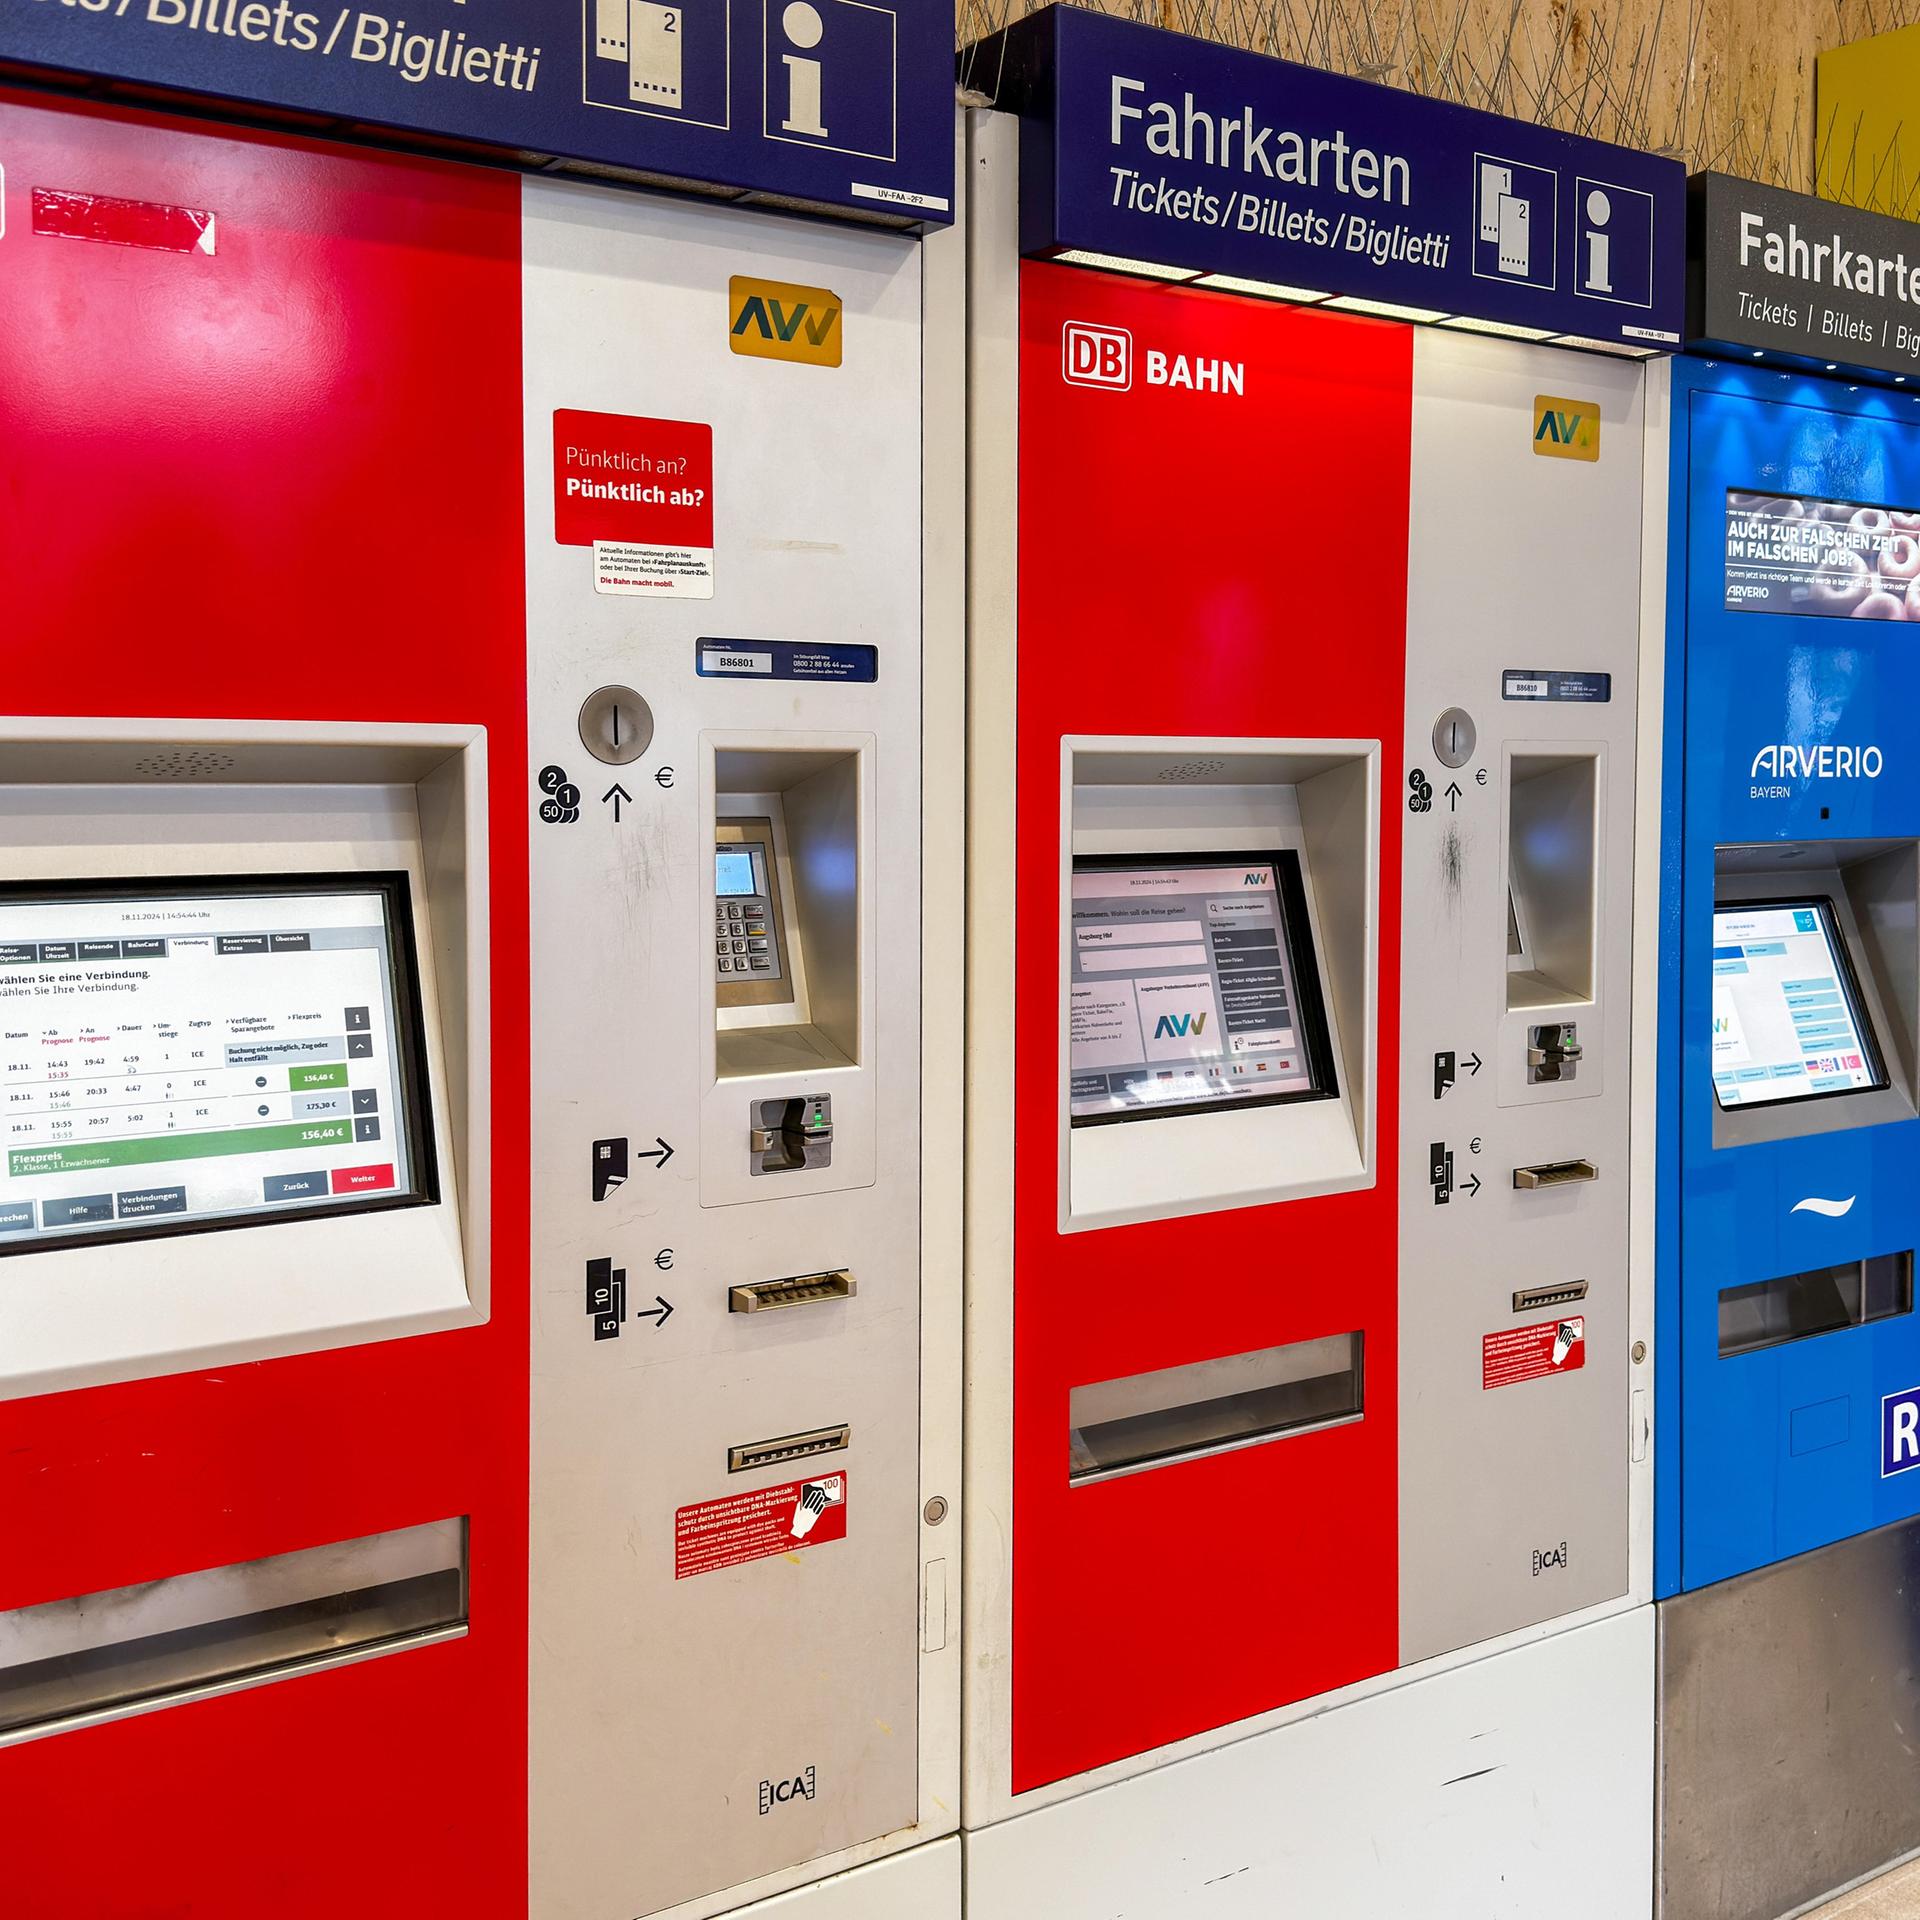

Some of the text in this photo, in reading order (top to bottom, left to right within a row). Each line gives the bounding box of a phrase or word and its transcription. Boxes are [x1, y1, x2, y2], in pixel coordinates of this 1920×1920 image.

[1110, 74, 1411, 206] Fahrkarten
[1738, 291, 1798, 327] Tickets
[1821, 309, 1873, 343] Billets
[1072, 332, 1245, 396] DB BAHN
[566, 446, 688, 476] Pünktlich an?
[566, 478, 705, 507] Pünktlich ab?
[1728, 520, 1900, 553] AUCH ZUR FALSCHEN ZEIT
[600, 547, 623, 555] Aktuelle
[624, 548, 664, 557] Informationen
[1728, 540, 1853, 568] IM FALSCHEN JOB?
[610, 556, 641, 564] Automaten
[624, 565, 639, 573] Ihrer
[640, 567, 664, 575] Buchung
[665, 567, 677, 575] über
[1727, 569, 1745, 578] Komm
[1745, 571, 1758, 580] jetzt
[1768, 573, 1789, 582] richtige
[1789, 574, 1803, 582] Team
[1804, 576, 1815, 584] und
[632, 579, 652, 587] macht
[1727, 585, 1769, 598] ARVERIO
[720, 657, 754, 668] B86801
[1750, 744, 1883, 778] ARVERIO
[547, 773, 557, 788] 2
[564, 789, 571, 804] 1
[1750, 786, 1790, 799] BAYERN
[543, 806, 559, 818] 50
[121, 912, 161, 921] 18.11.2024
[45, 945, 66, 953] Datum
[127, 941, 159, 949] BahnCard
[173, 939, 209, 947] Verbindung
[39, 970, 151, 983] Sie eine Verbindung.
[35, 982, 139, 995] Sie Ihre Verbindung.
[188, 1020, 212, 1028] Zugtyp
[230, 1016, 267, 1025] Verfügbare
[292, 1013, 322, 1021] Flexpreis
[41, 1024, 275, 1046] Prognose Prognose Sparangebote
[228, 1047, 256, 1056] Buchung
[257, 1045, 273, 1053] nicht
[47, 1060, 68, 1068] 14:43
[84, 1058, 105, 1066] 19:42
[48, 1071, 69, 1079] 15:35
[49, 1090, 70, 1098] 15:46
[86, 1087, 107, 1095] 20:33
[12, 1124, 36, 1132] 18.11.
[51, 1120, 72, 1129] 15:55
[88, 1117, 109, 1126] 20:57
[13, 1128, 344, 1165] Flexpreis 156,40 €
[61, 1158, 110, 1168] Erwachsener
[69, 1174, 375, 1215] Hilfe Verbindungen Zurück Weiter
[122, 1203, 155, 1213] drucken
[595, 1288, 609, 1305] 10
[603, 1320, 616, 1331] 5
[824, 1478, 838, 1490] 100
[678, 1510, 698, 1518] Unsere
[700, 1502, 731, 1513] Automaten
[733, 1496, 754, 1506] werden
[766, 1487, 794, 1499] Diebstahl-
[678, 1495, 798, 1527] schutz durch unsichtbare DNA-Markierung
[678, 1509, 771, 1536] und Farbeinspritzung gesichert.
[1539, 1550, 1561, 1570] ICA
[770, 1777, 806, 1805] ICA
